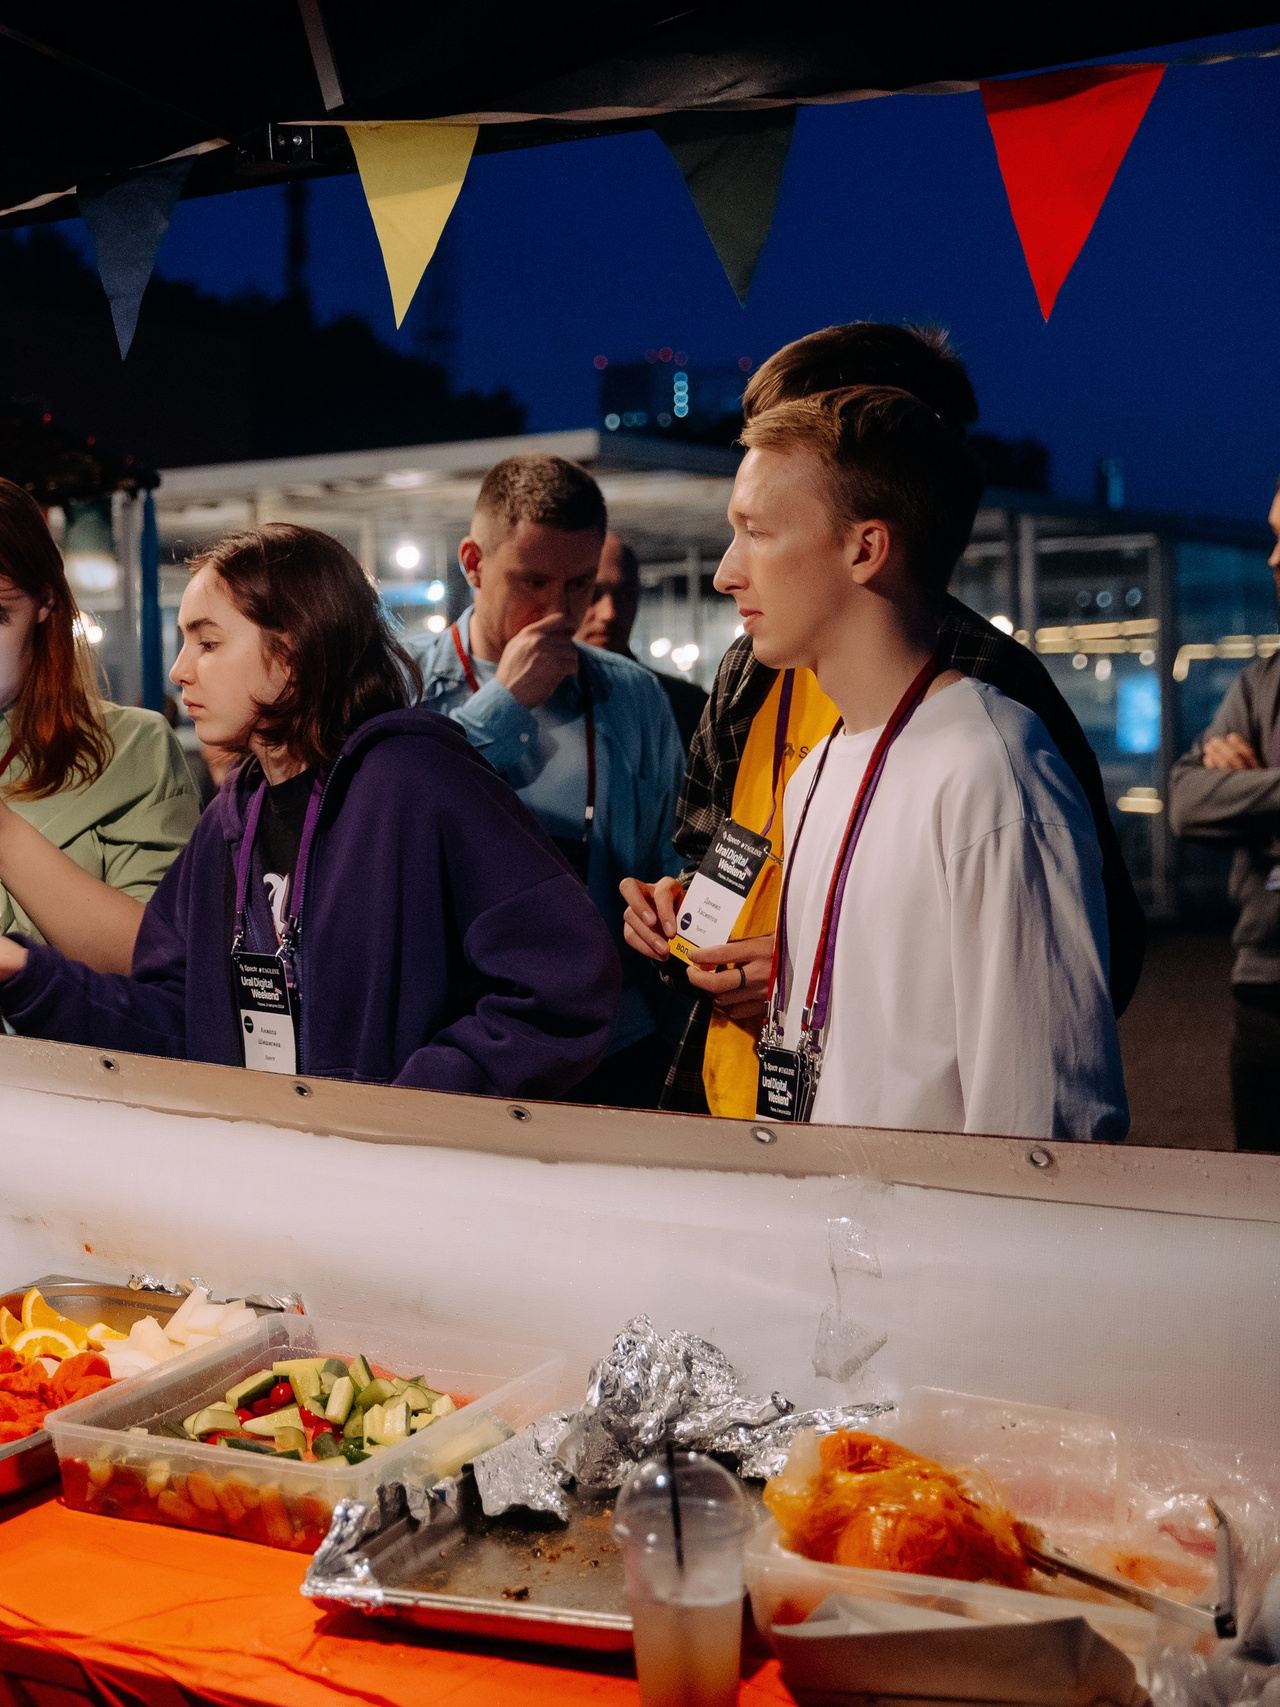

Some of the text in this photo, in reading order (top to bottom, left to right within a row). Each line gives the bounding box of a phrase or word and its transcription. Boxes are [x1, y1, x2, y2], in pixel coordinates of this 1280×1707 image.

[726, 833, 741, 846] Spectr
[714, 842, 748, 869] Ural Digital
[718, 858, 747, 880] Weekend
[244, 964, 258, 973] Spectr
[241, 976, 273, 990] Ural Digital
[251, 988, 280, 1001] Weekend
[762, 1076, 787, 1093] Ural Digital
[767, 1090, 789, 1106] Weekend
